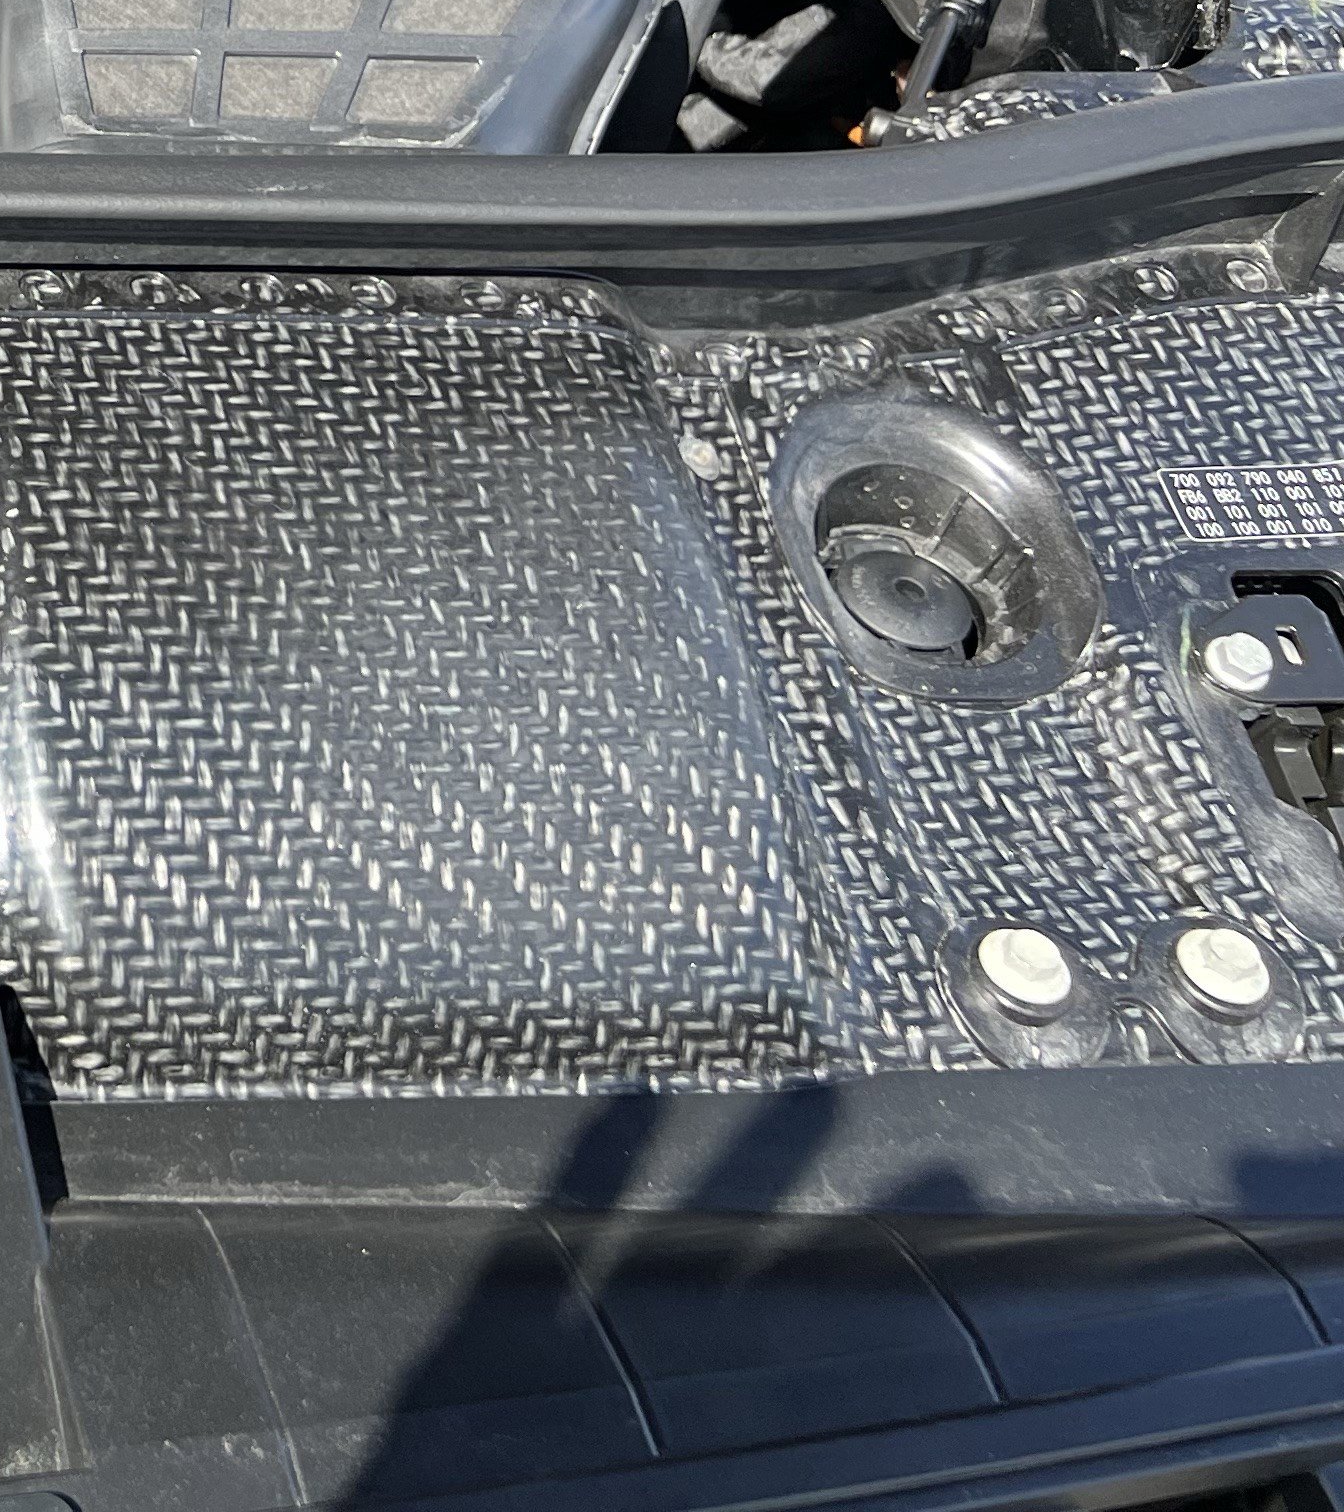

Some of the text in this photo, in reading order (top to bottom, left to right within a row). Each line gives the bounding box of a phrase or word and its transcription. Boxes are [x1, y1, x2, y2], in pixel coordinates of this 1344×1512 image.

[1169, 467, 1342, 488] 700 092 790 040 851
[1177, 489, 1208, 505] FB6
[1250, 487, 1281, 502] 110
[1284, 485, 1315, 500] 001
[1185, 506, 1216, 521] 001
[1223, 505, 1252, 519] 101
[1257, 504, 1288, 518] 001
[1294, 502, 1324, 517] 101
[1195, 522, 1225, 537] 100
[1231, 521, 1261, 535] 100
[1266, 520, 1296, 534] 001
[1302, 518, 1333, 533] 010
